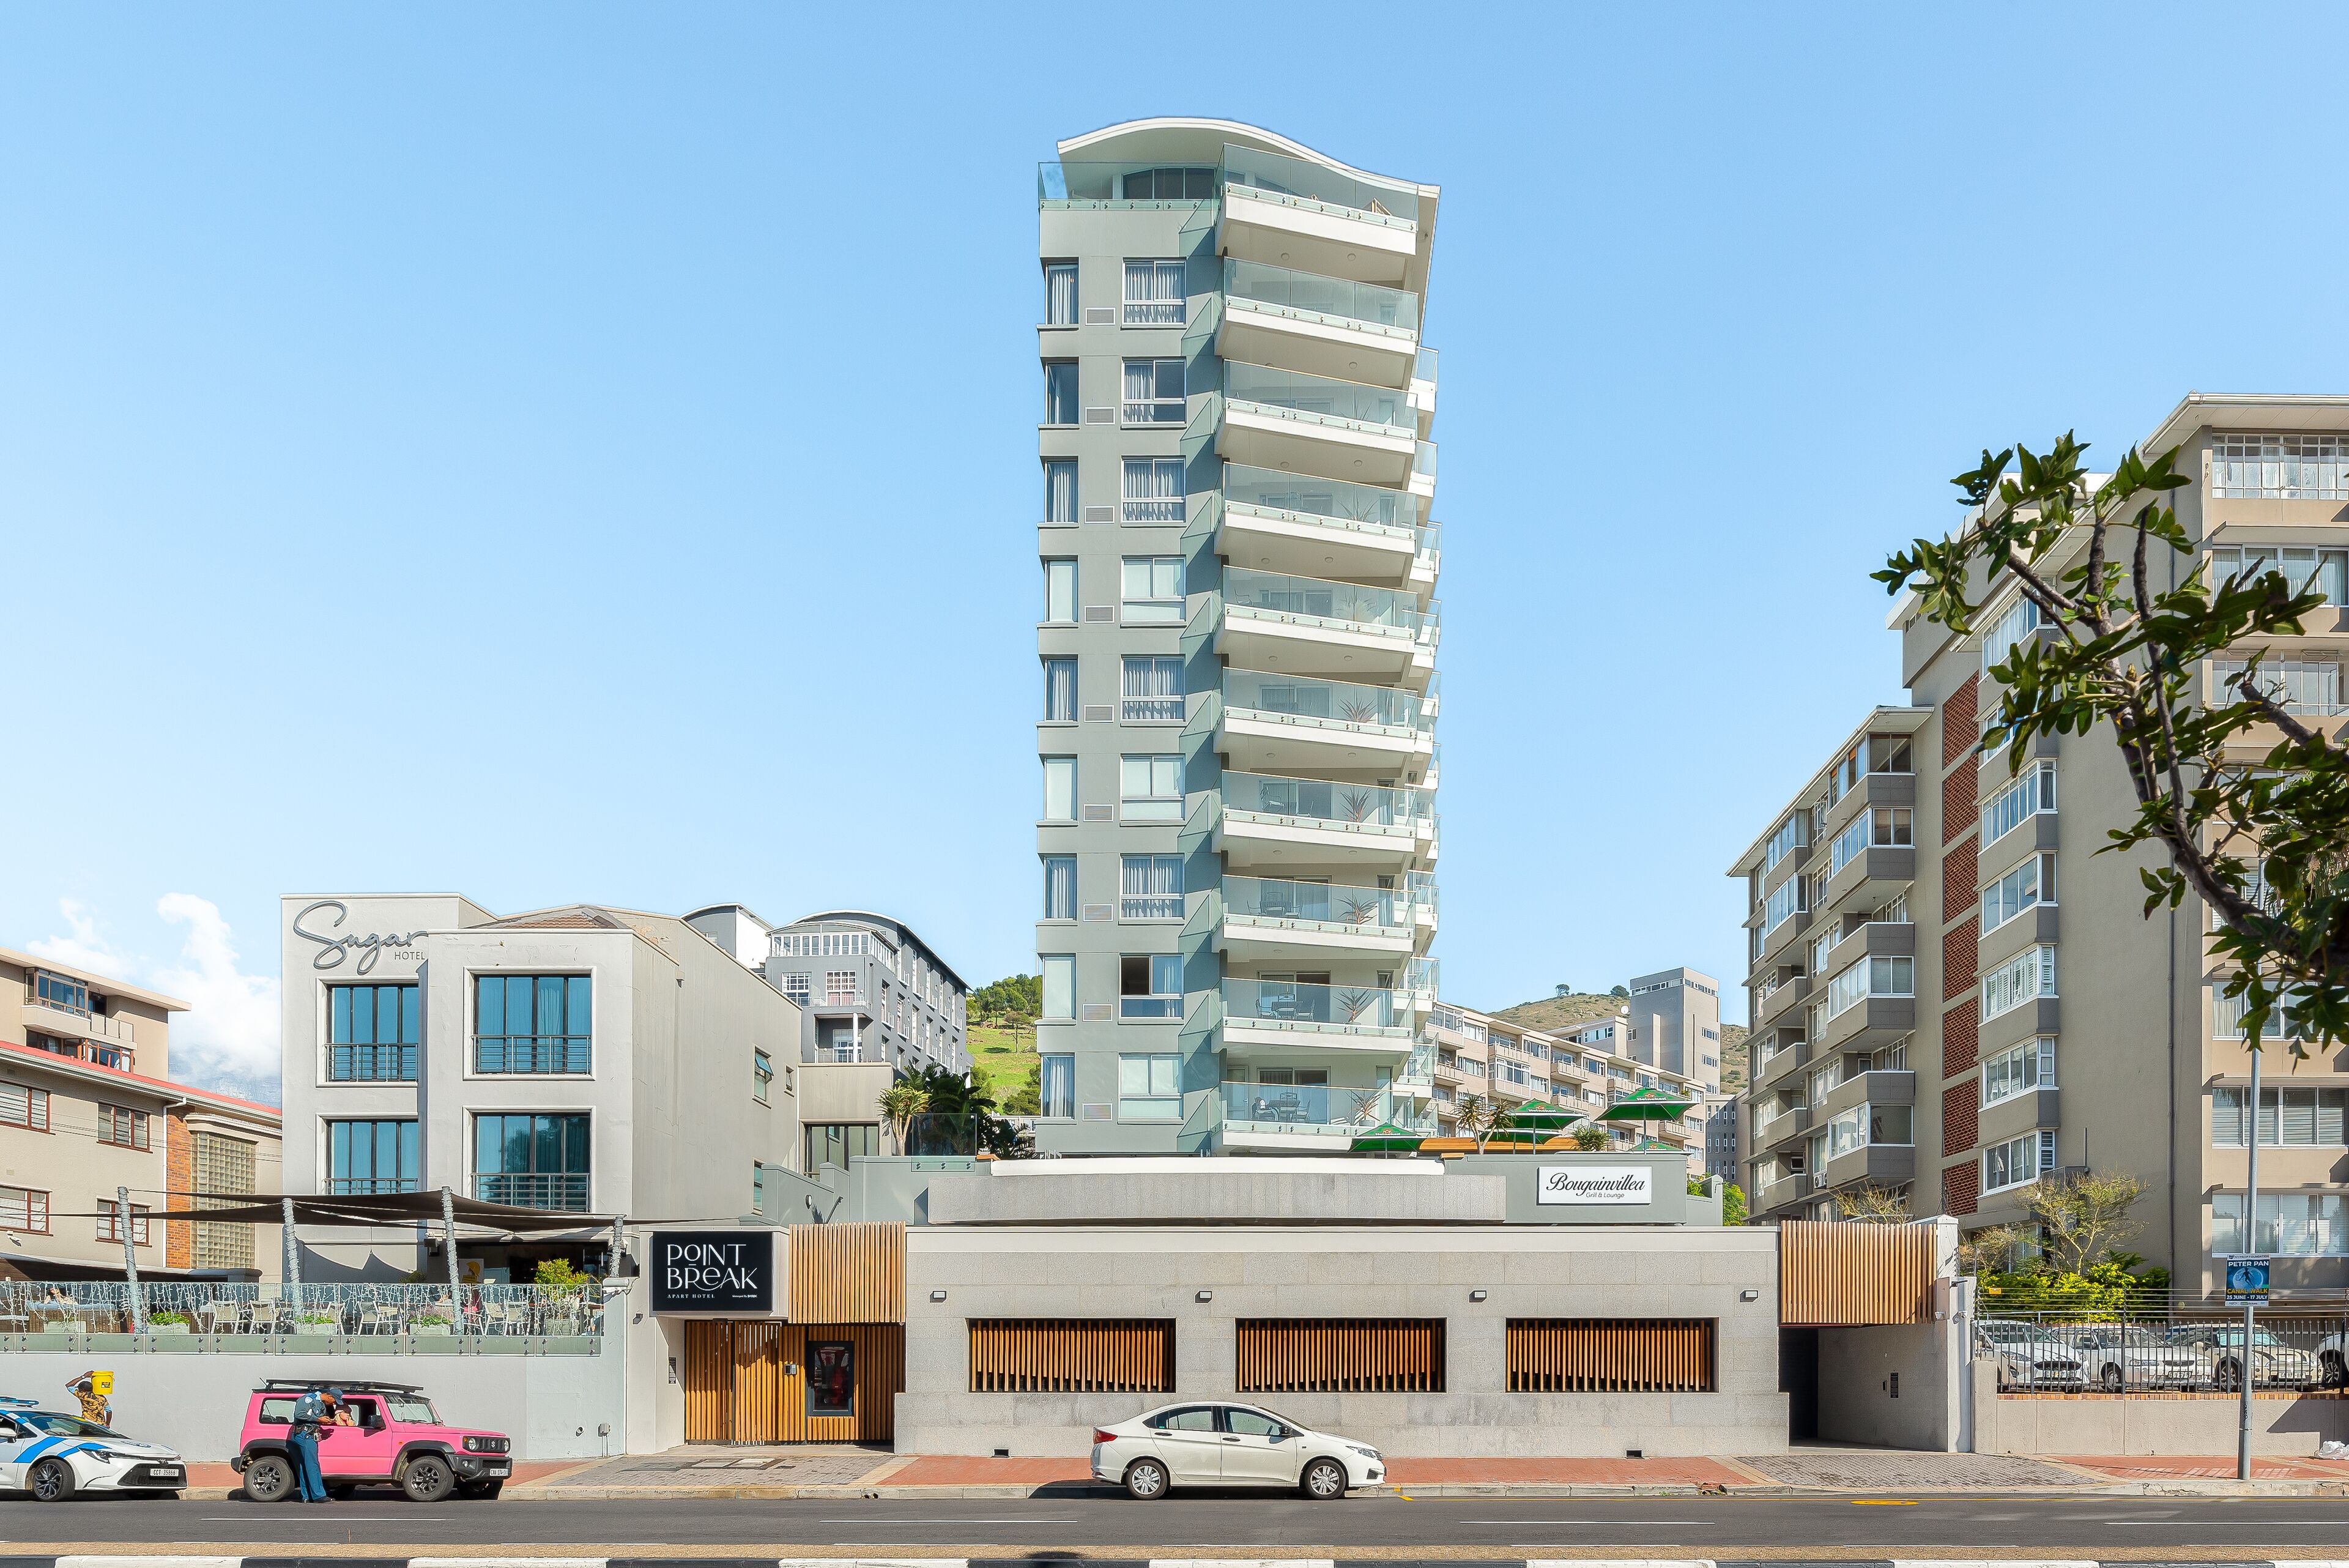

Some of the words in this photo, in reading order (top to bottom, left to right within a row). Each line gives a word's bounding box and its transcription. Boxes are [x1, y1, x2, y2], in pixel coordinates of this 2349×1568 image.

[293, 900, 429, 976] Sugar
[394, 951, 425, 960] HOTEL
[1546, 1172, 1646, 1197] Bougainvillea
[667, 1244, 747, 1266] POINT
